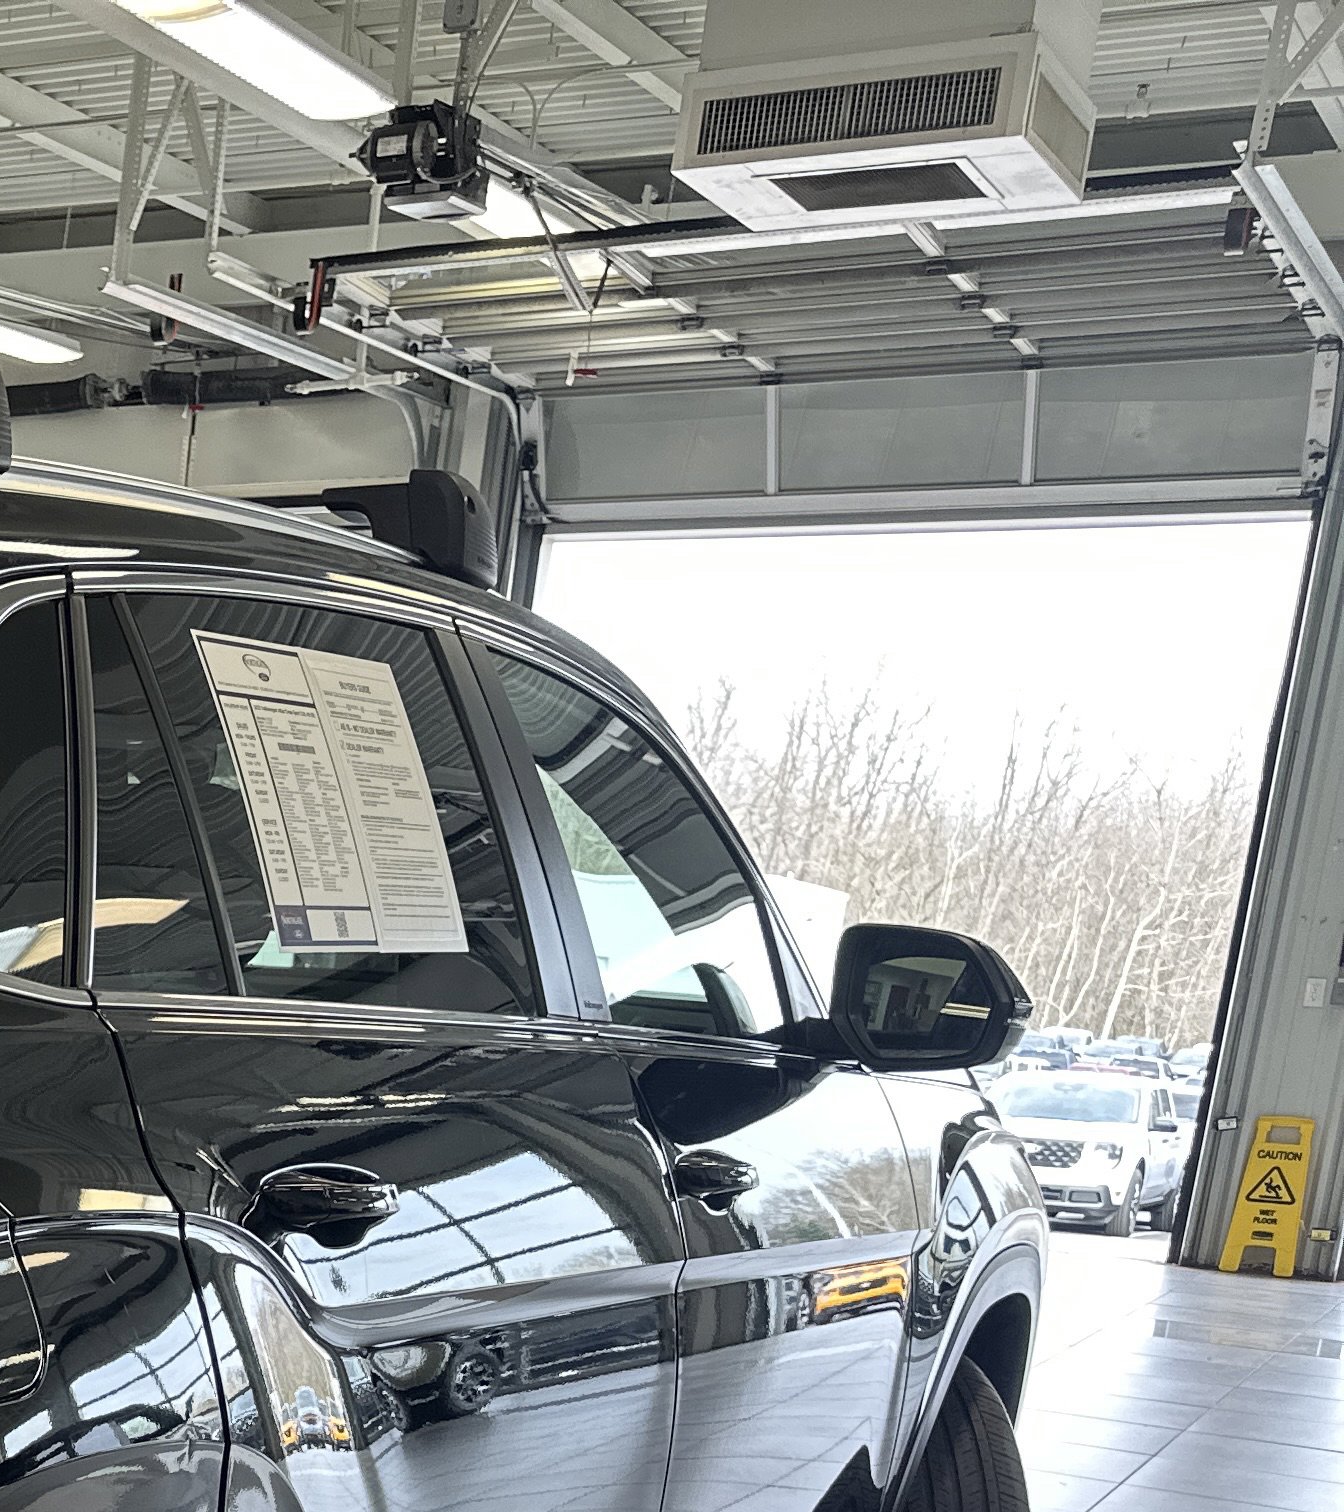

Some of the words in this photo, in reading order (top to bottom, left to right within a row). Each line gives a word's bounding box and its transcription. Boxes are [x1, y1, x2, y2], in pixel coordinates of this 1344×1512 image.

[1257, 1149, 1302, 1162] CAUTION
[1259, 1209, 1276, 1217] WET
[1253, 1216, 1277, 1226] FLOOR
